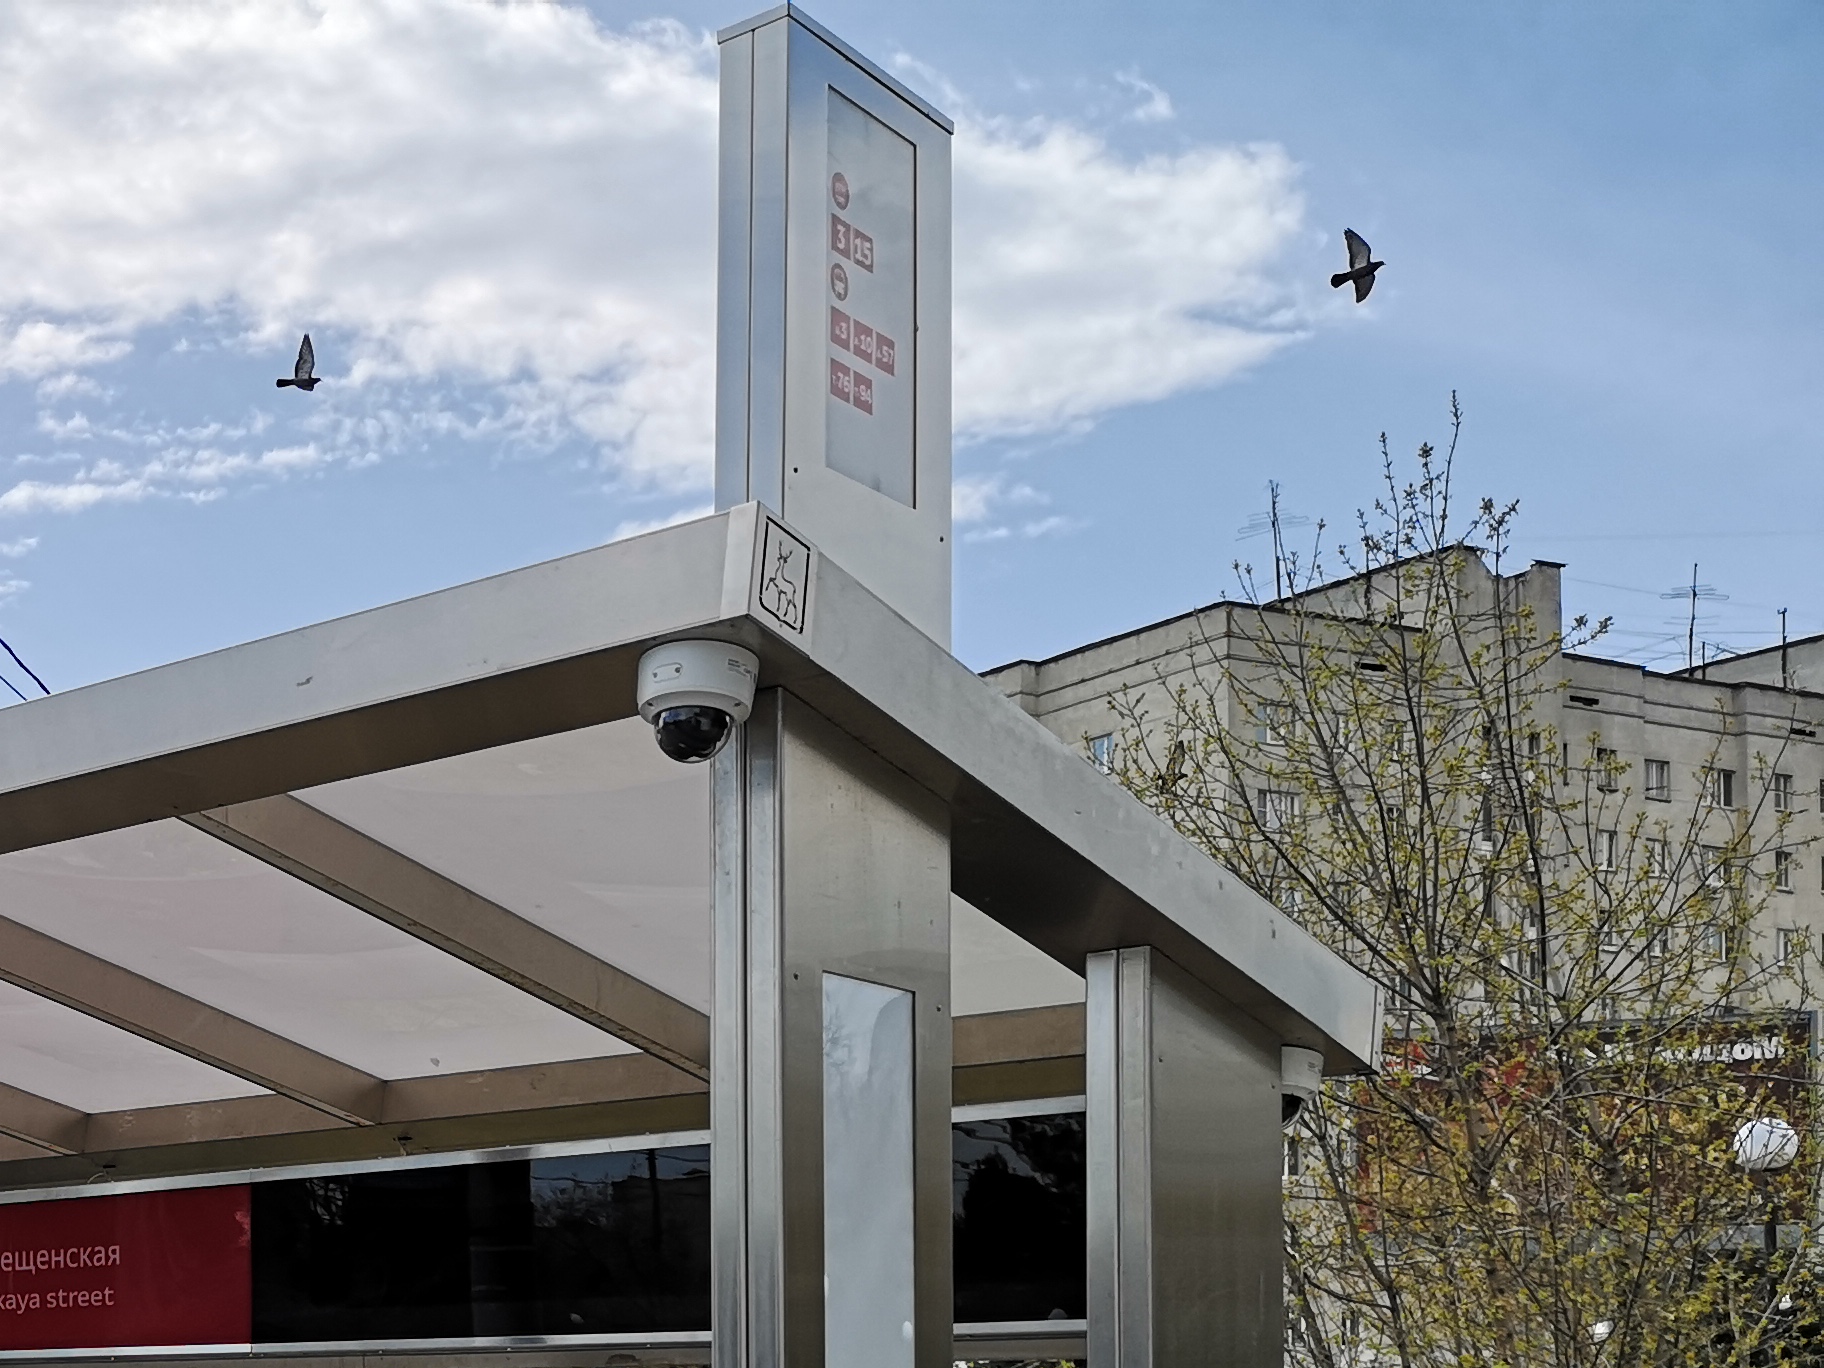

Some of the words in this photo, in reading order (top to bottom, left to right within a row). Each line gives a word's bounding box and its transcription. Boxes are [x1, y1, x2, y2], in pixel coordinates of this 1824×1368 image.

[836, 223, 846, 250] 3
[854, 237, 872, 266] 15
[46, 1286, 115, 1308] street
